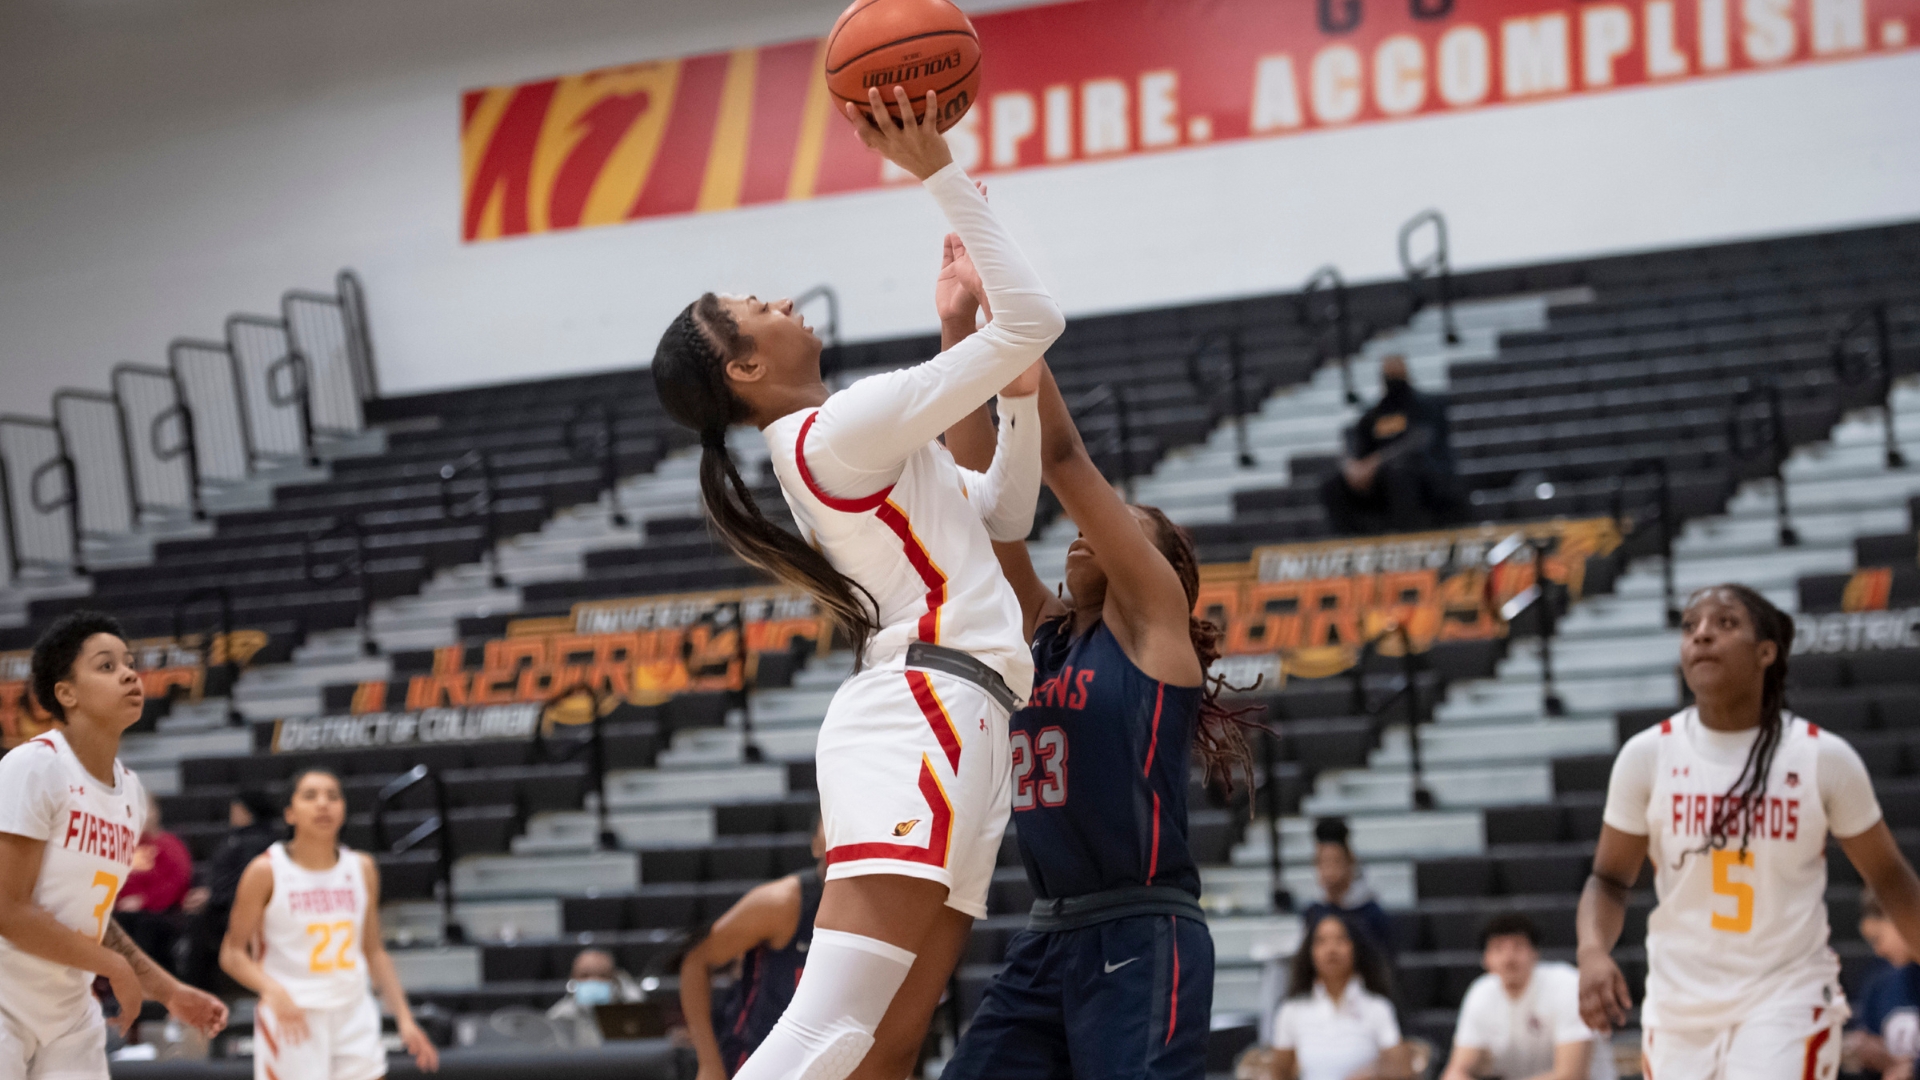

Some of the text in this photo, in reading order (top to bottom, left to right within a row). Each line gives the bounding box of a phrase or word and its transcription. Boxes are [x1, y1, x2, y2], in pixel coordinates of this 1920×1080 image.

[862, 52, 960, 88] EVOLUTION
[1250, 0, 1907, 134] ACCOMPLISH.
[1010, 725, 1069, 812] 23
[1672, 794, 1799, 841] FIREBIRDS
[1710, 848, 1755, 934] 5
[306, 919, 357, 974] 22
